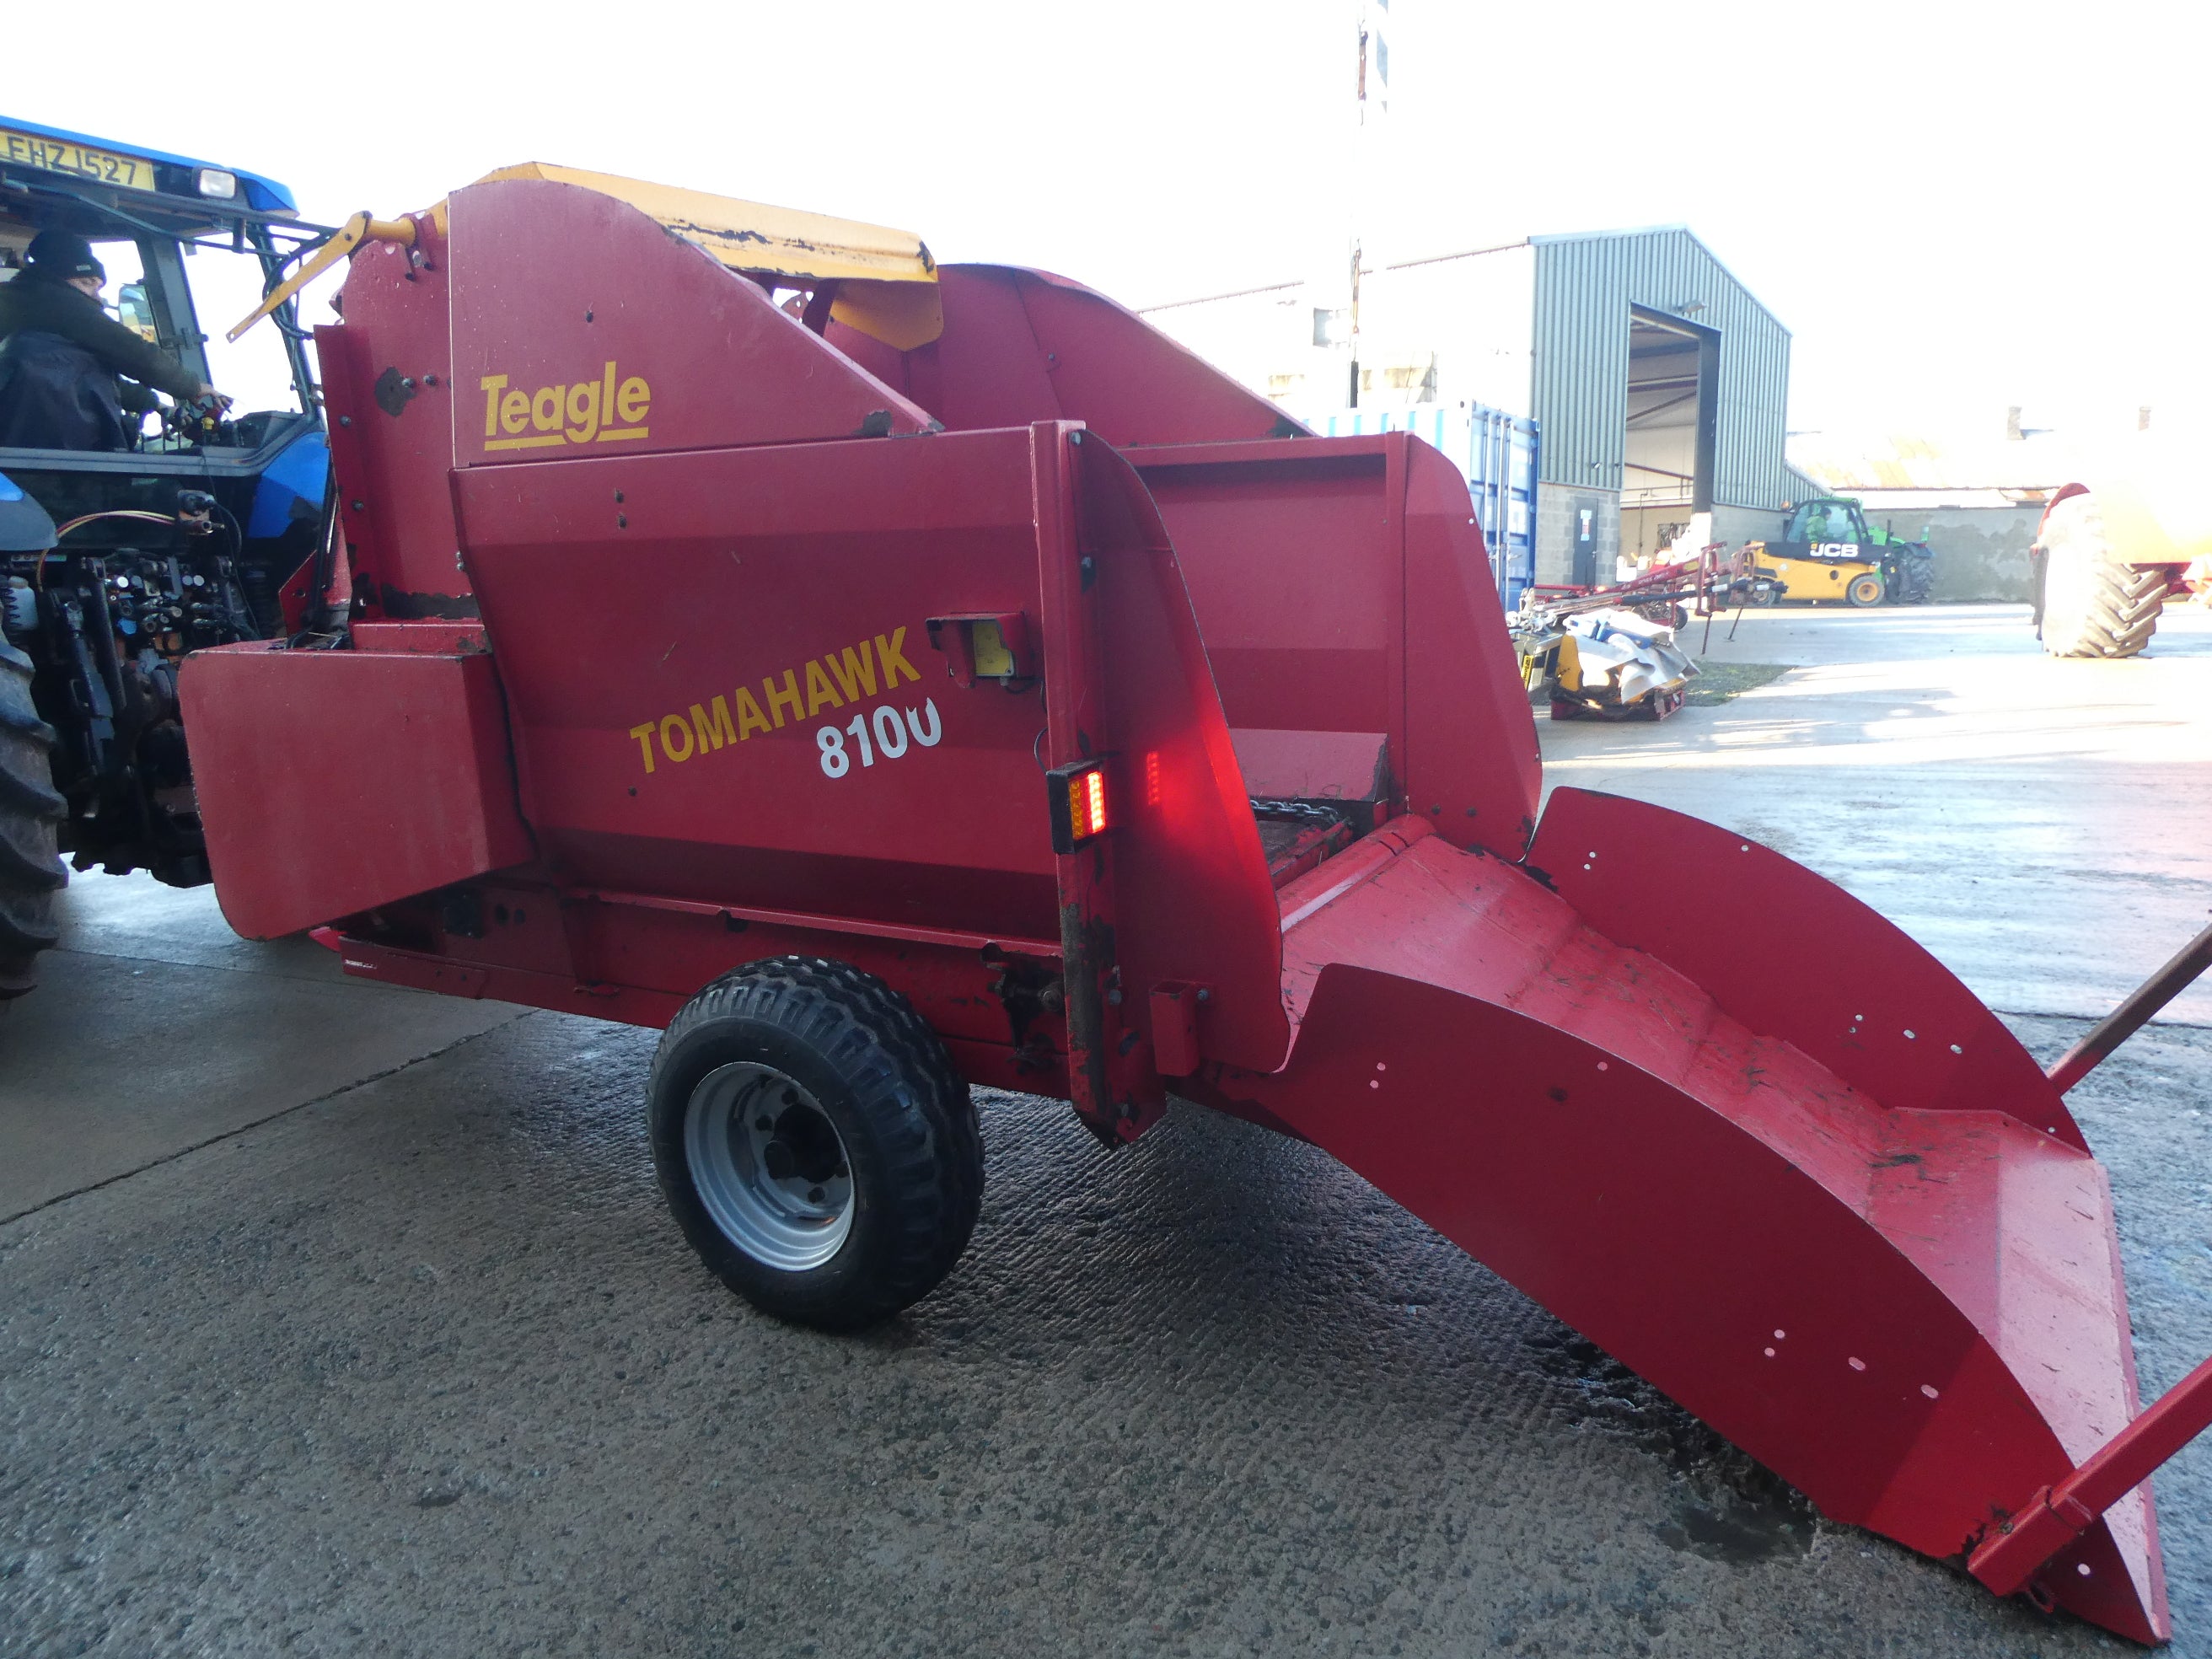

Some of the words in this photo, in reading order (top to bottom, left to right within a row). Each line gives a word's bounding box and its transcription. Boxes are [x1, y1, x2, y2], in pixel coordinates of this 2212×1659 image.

[74, 147, 137, 186] 1527
[481, 361, 651, 443] Teagle
[1809, 542, 1859, 558] JCB
[629, 625, 922, 774] TOMAHAWK
[815, 696, 942, 779] 8100
